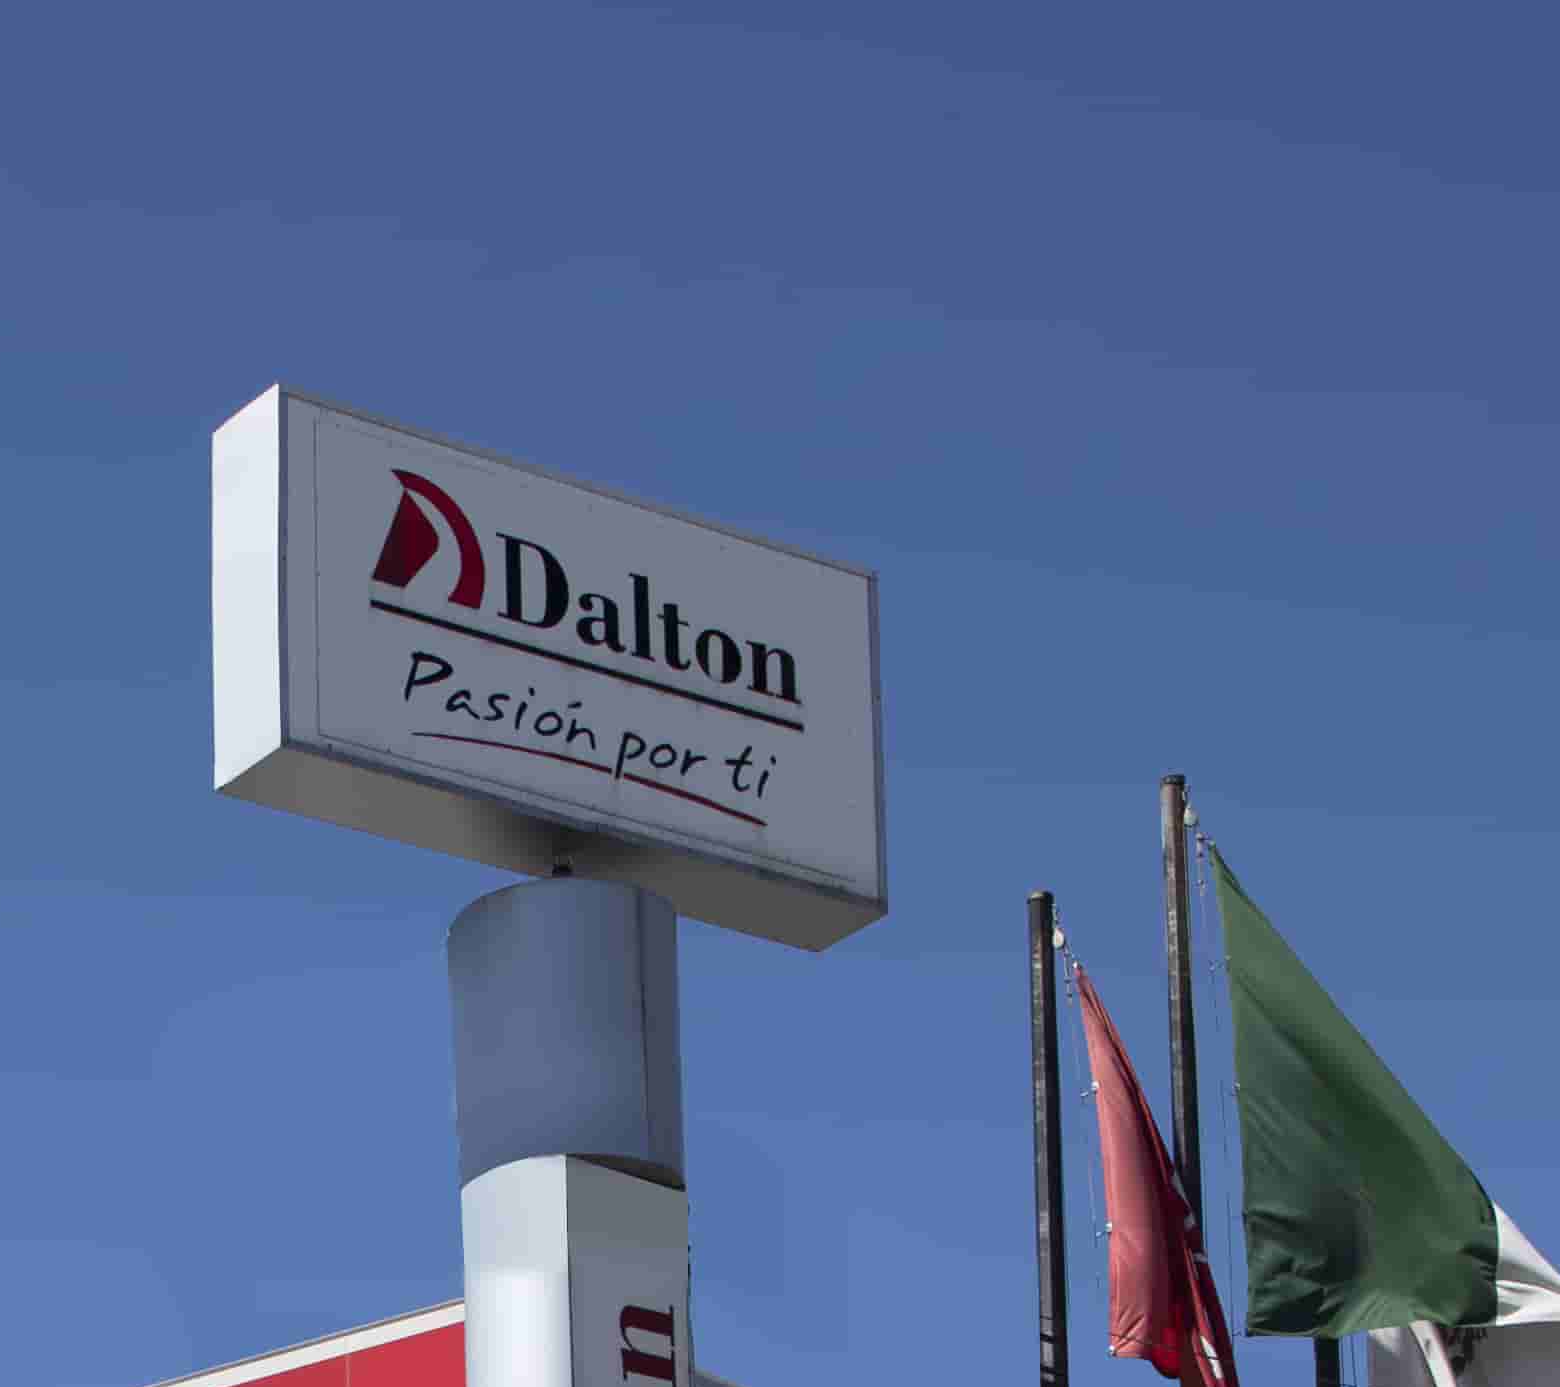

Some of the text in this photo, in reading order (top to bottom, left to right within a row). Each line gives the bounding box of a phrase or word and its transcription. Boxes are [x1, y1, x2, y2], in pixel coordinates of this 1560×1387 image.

[496, 532, 803, 706] Dalton
[404, 651, 778, 800] Pasión por ti
